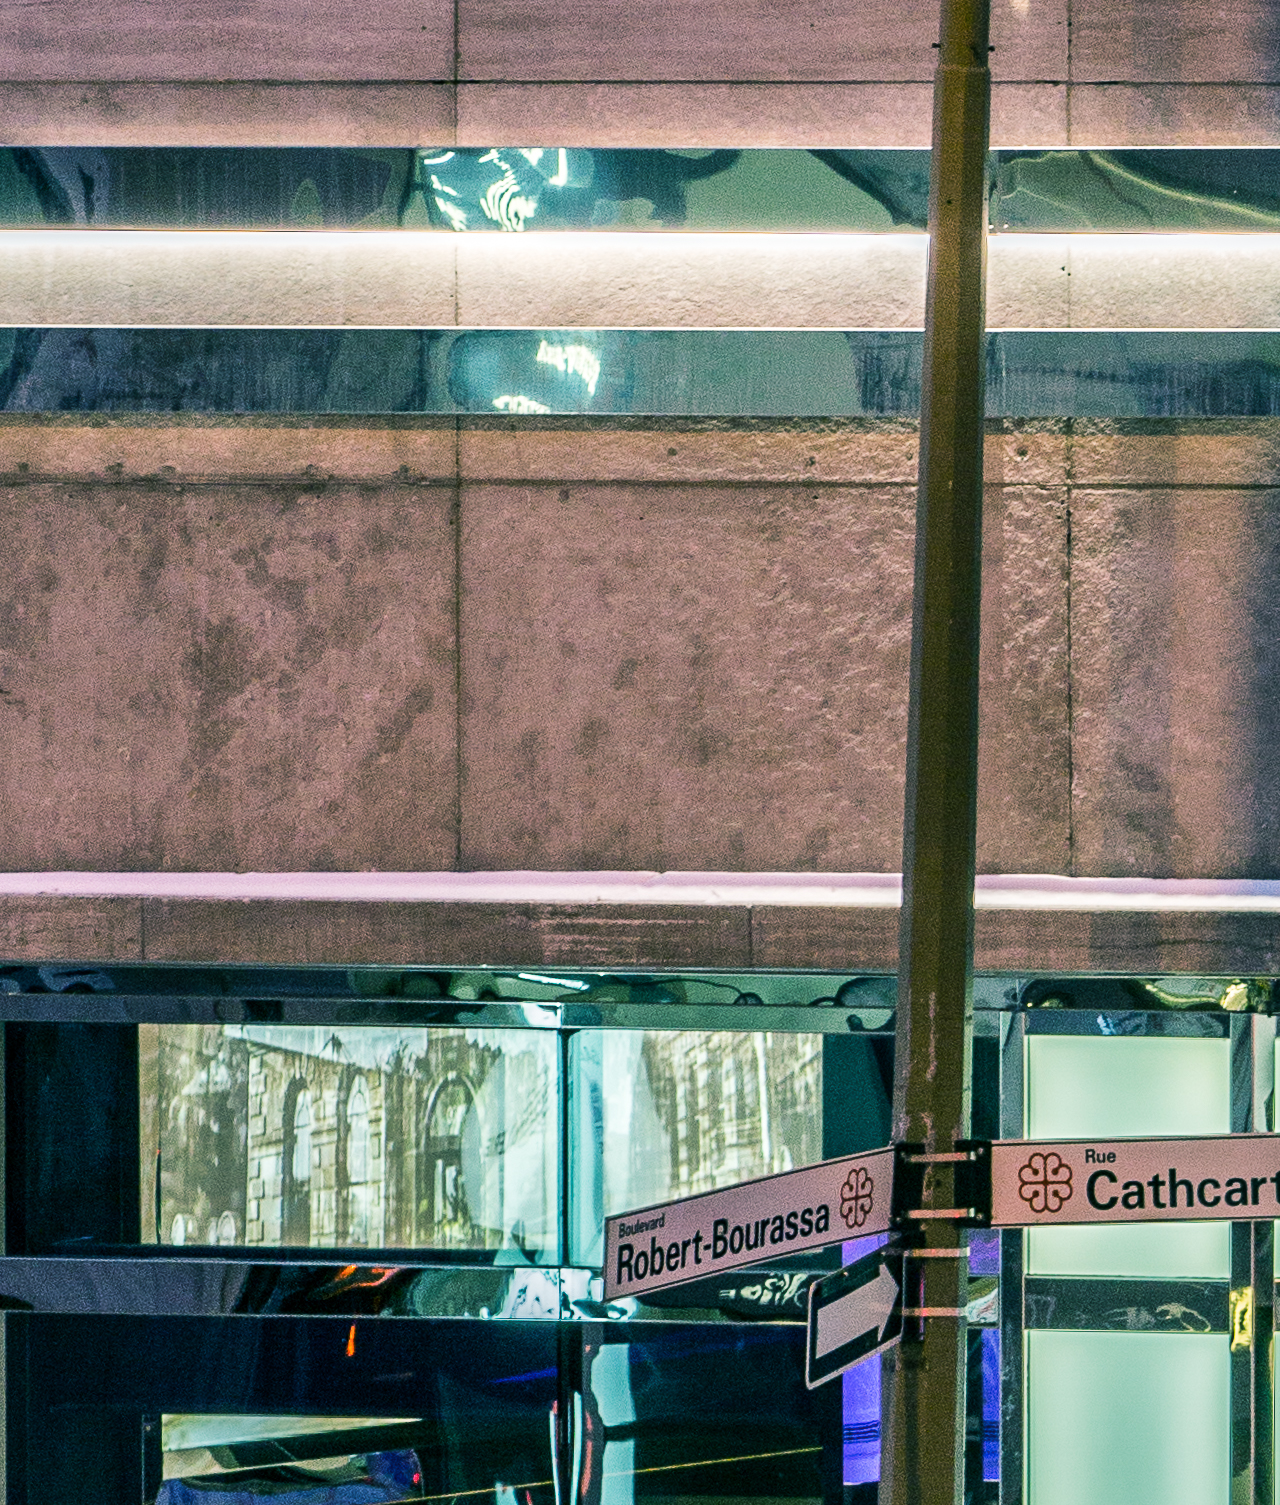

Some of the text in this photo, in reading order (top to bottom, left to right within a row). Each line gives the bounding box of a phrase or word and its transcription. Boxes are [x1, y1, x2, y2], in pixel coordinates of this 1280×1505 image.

[1084, 1148, 1117, 1164] Rue
[618, 1213, 666, 1239] Boulevard
[616, 1203, 830, 1285] Robert-Bourassa
